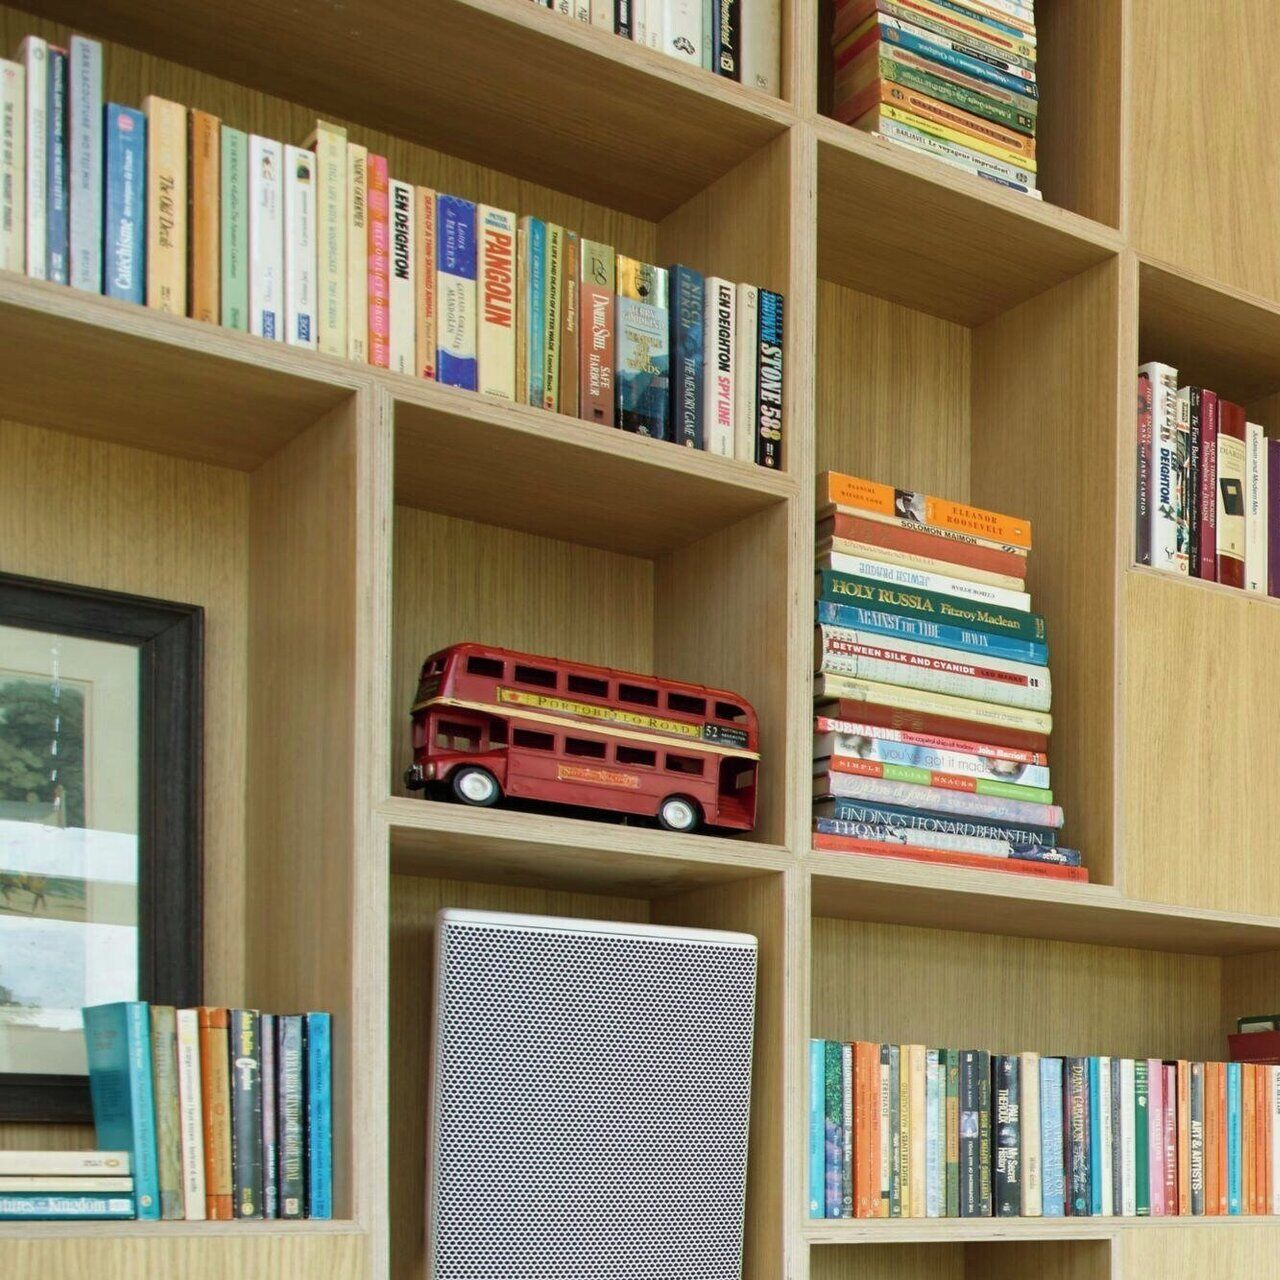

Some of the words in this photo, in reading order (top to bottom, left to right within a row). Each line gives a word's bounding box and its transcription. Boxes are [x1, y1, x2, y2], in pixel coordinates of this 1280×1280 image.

[395, 187, 409, 211] LEN
[395, 213, 409, 279] DEIGHTON
[484, 230, 512, 328] PANGOLIN
[718, 285, 730, 311] LEN
[718, 312, 730, 372] DEIGHTON
[760, 343, 782, 403] STONE
[684, 374, 696, 409] MEMORY
[718, 376, 730, 400] SPY
[684, 410, 695, 437] GAME
[718, 403, 730, 427] LINE
[760, 407, 782, 441] 588
[1160, 447, 1171, 504] DEIGHTON
[901, 520, 942, 537] SOLOMON
[945, 530, 977, 544] MAIMON
[832, 580, 874, 601] HOLY
[878, 589, 934, 612] RUSSIA
[977, 611, 1020, 629] Maclean
[833, 641, 881, 657] BETWEEN
[884, 651, 907, 662] SILK
[911, 655, 931, 667] AND
[934, 660, 975, 675] CYANIDE
[649, 718, 691, 734] ROAD
[705, 726, 718, 737] 52
[884, 749, 922, 763] you've
[925, 754, 945, 767] got
[840, 807, 907, 827] FINDINGS
[911, 816, 975, 837] LEONARD
[975, 822, 1043, 845] BERNSTEIN
[998, 1090, 1009, 1124] THEROUX
[1192, 1120, 1202, 1141] ART
[997, 1147, 1008, 1173] History
[1008, 1160, 1017, 1183] Secret
